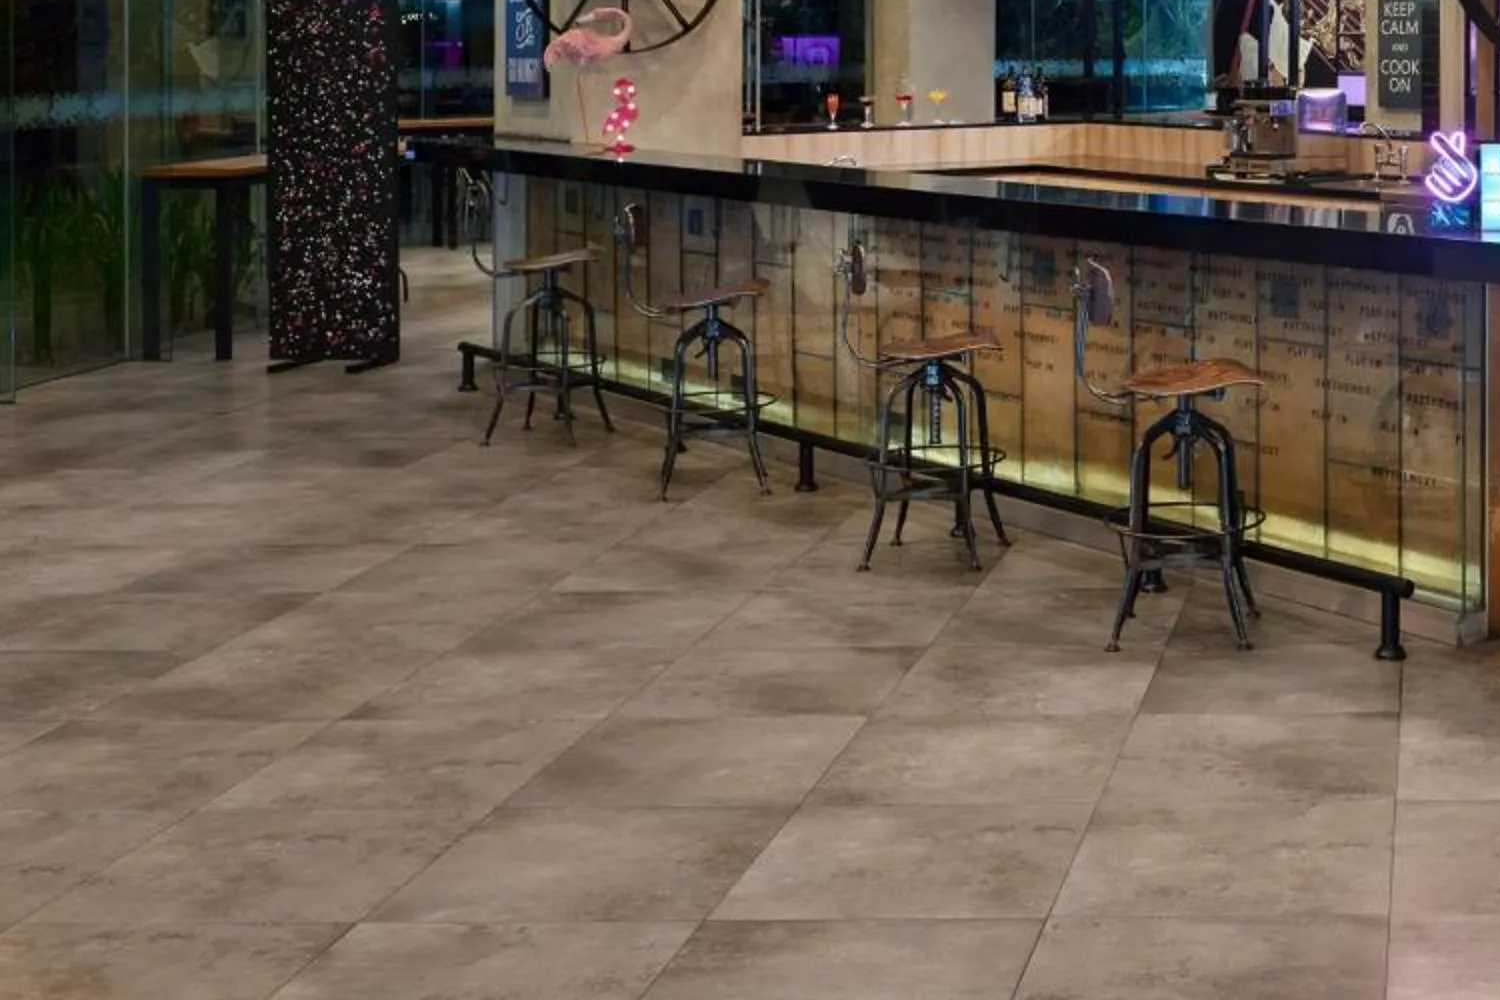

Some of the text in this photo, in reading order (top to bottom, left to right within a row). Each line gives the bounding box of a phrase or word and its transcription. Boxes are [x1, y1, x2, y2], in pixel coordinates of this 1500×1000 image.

[1383, 1, 1417, 17] KEEP
[1380, 18, 1420, 35] CALM
[1380, 59, 1421, 76] COOK
[1388, 77, 1412, 93] ON
